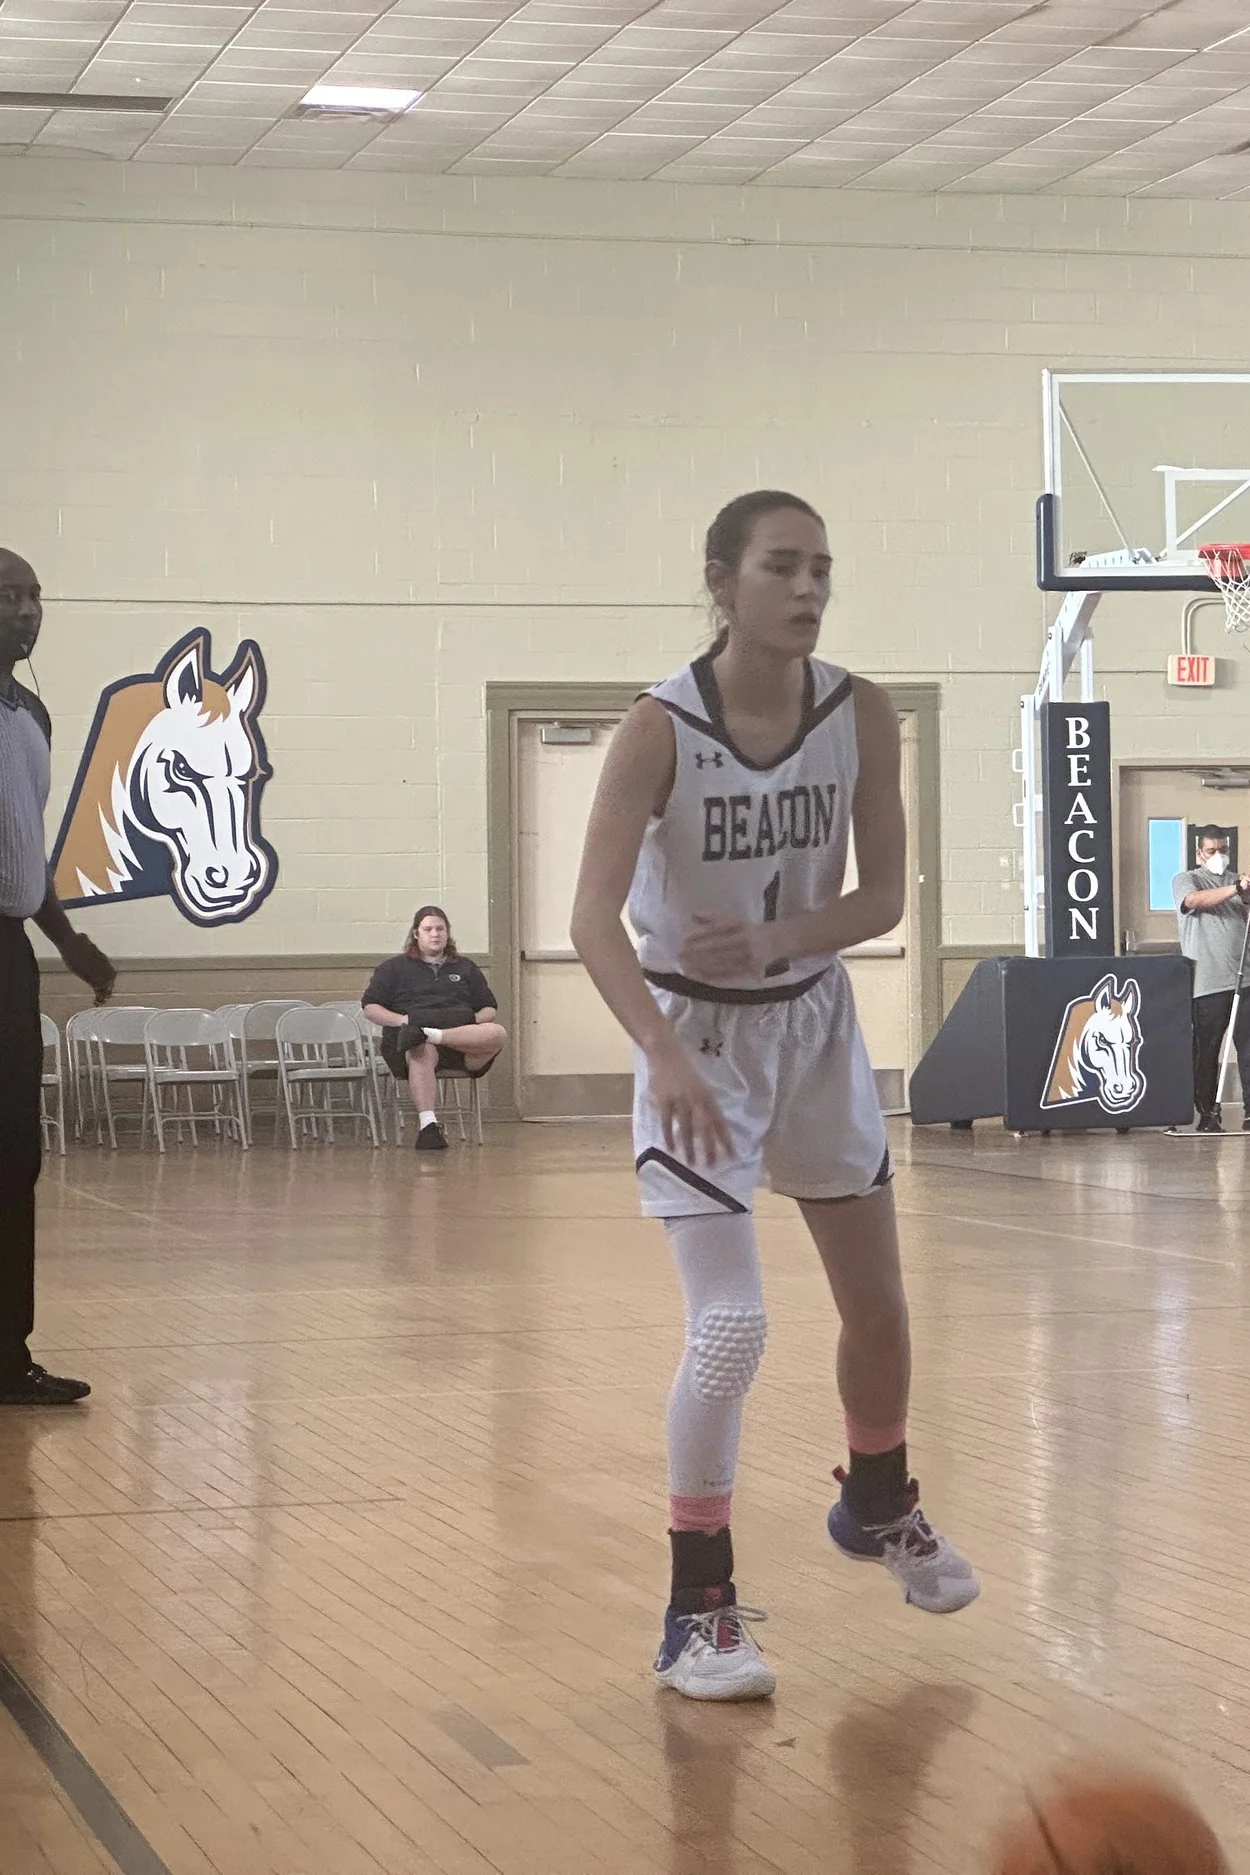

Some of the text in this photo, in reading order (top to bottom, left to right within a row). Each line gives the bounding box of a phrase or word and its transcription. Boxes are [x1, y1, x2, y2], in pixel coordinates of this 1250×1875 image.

[1177, 656, 1209, 682] EXIT
[702, 783, 837, 862] BEACON
[1064, 717, 1099, 940] BEACON
